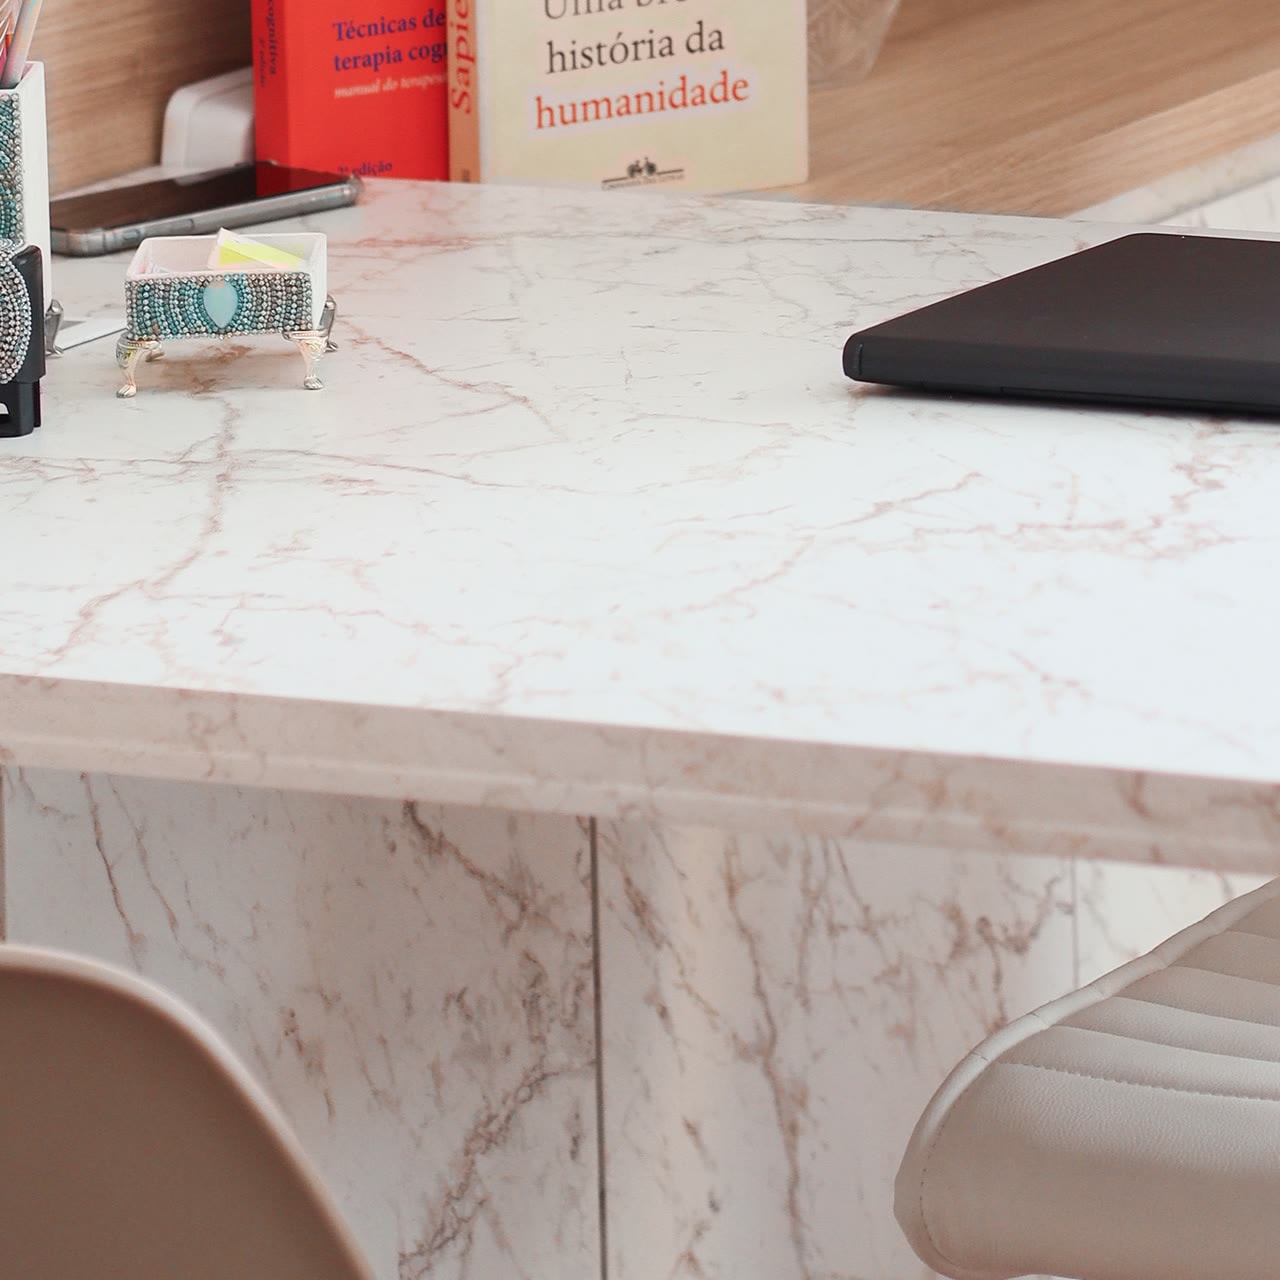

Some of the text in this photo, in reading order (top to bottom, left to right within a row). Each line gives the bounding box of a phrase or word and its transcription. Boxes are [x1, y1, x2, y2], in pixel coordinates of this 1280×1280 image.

[332, 8, 446, 42] Técnicas de
[333, 45, 405, 73] terapia
[546, 20, 725, 76] história da
[535, 69, 750, 131] humanidade
